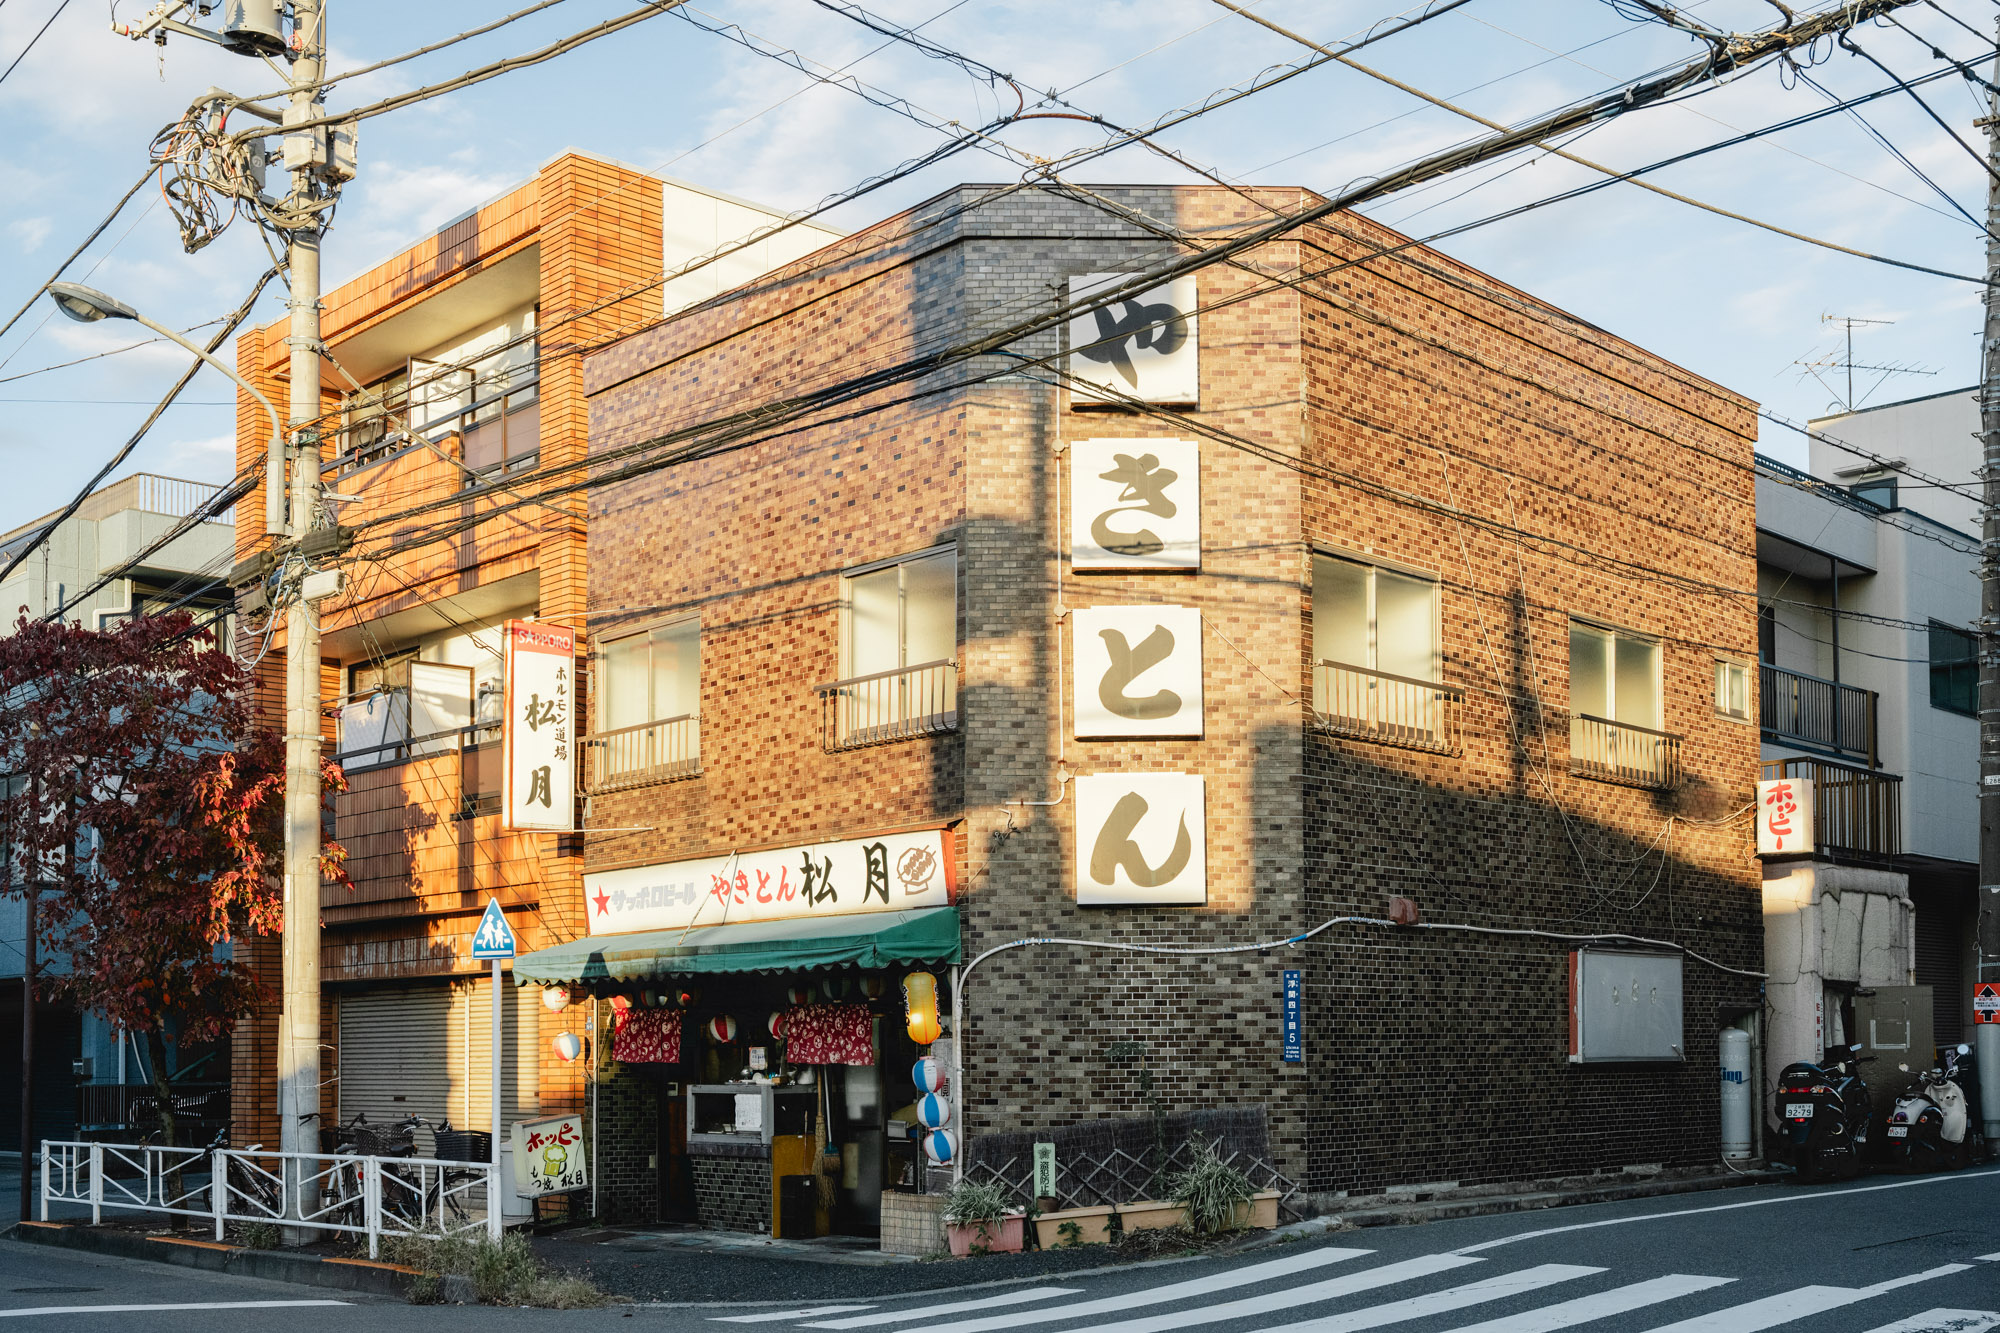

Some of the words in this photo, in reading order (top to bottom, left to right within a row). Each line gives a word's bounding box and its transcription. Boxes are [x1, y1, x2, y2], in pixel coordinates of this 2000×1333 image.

[1074, 298, 1192, 888] やきとん
[553, 666, 567, 761] ホルモン道場
[523, 692, 557, 809] 松月
[1766, 781, 1797, 851] ホッピー
[611, 881, 697, 912] サッポロビール
[710, 864, 798, 907] やきとん
[800, 841, 890, 909] 松月
[526, 1122, 580, 1153] ホッピー
[1787, 1109, 1812, 1117] 92-79
